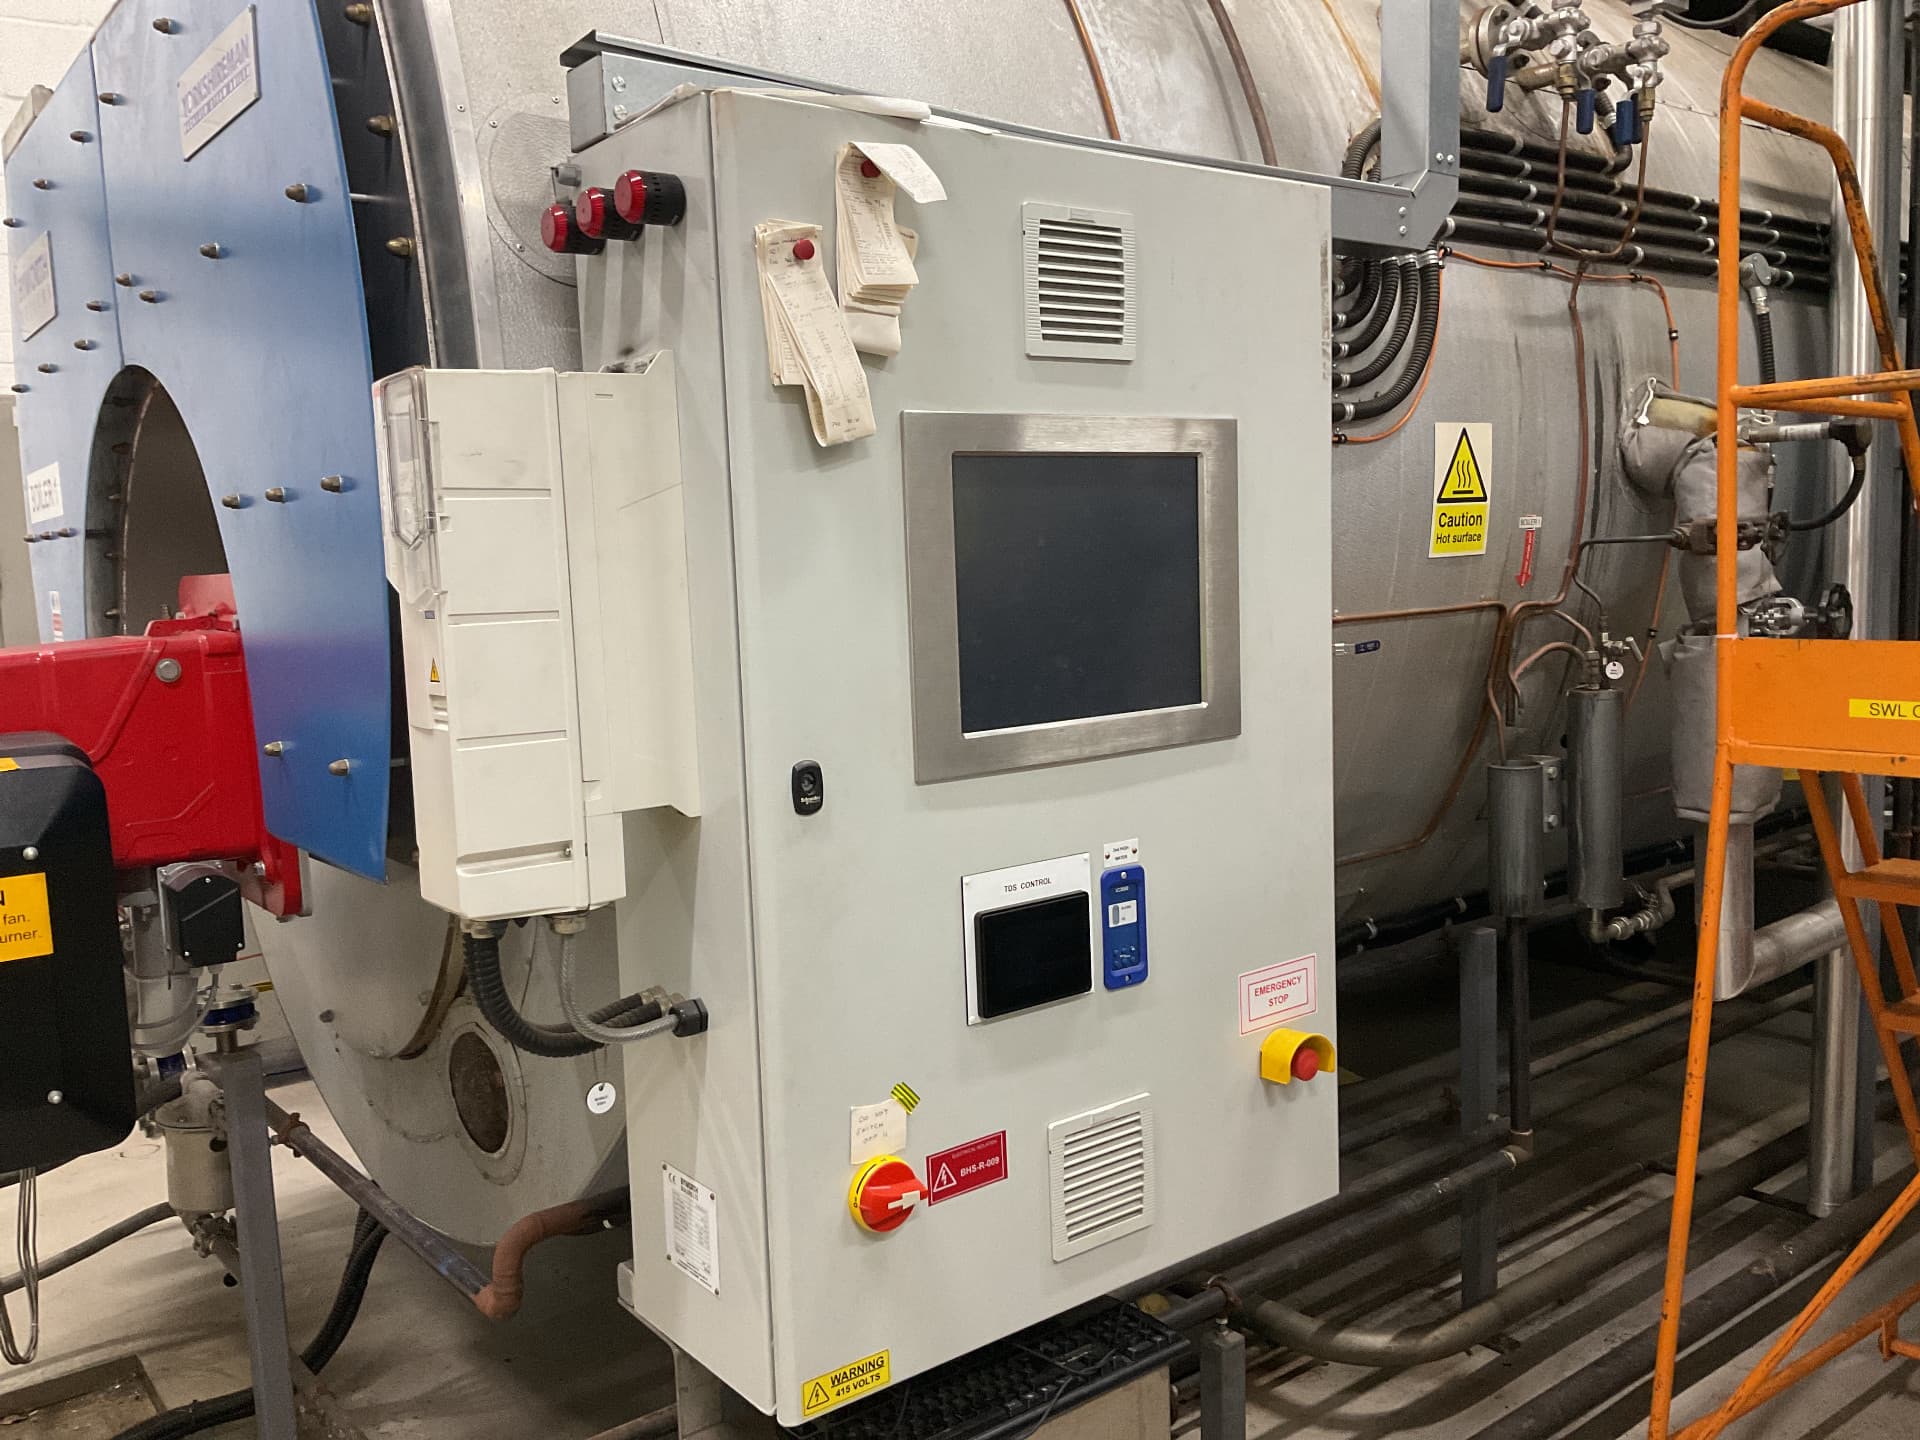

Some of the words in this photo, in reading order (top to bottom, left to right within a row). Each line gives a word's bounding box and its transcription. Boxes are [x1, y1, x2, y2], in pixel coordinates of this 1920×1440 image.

[1438, 511, 1483, 528] Caution
[1436, 533, 1450, 544] Hot
[1452, 531, 1482, 543] surface
[1869, 702, 1907, 718] SWL
[1020, 877, 1052, 890] CONTROL
[3, 913, 30, 926] fan.
[1254, 975, 1302, 997] EMERGENCY
[1268, 993, 1289, 1007] STOP
[960, 1155, 1000, 1177] BHS-R-009
[830, 1355, 885, 1387] WARNING
[836, 1384, 851, 1397] 415
[852, 1372, 881, 1391] VOLTS
